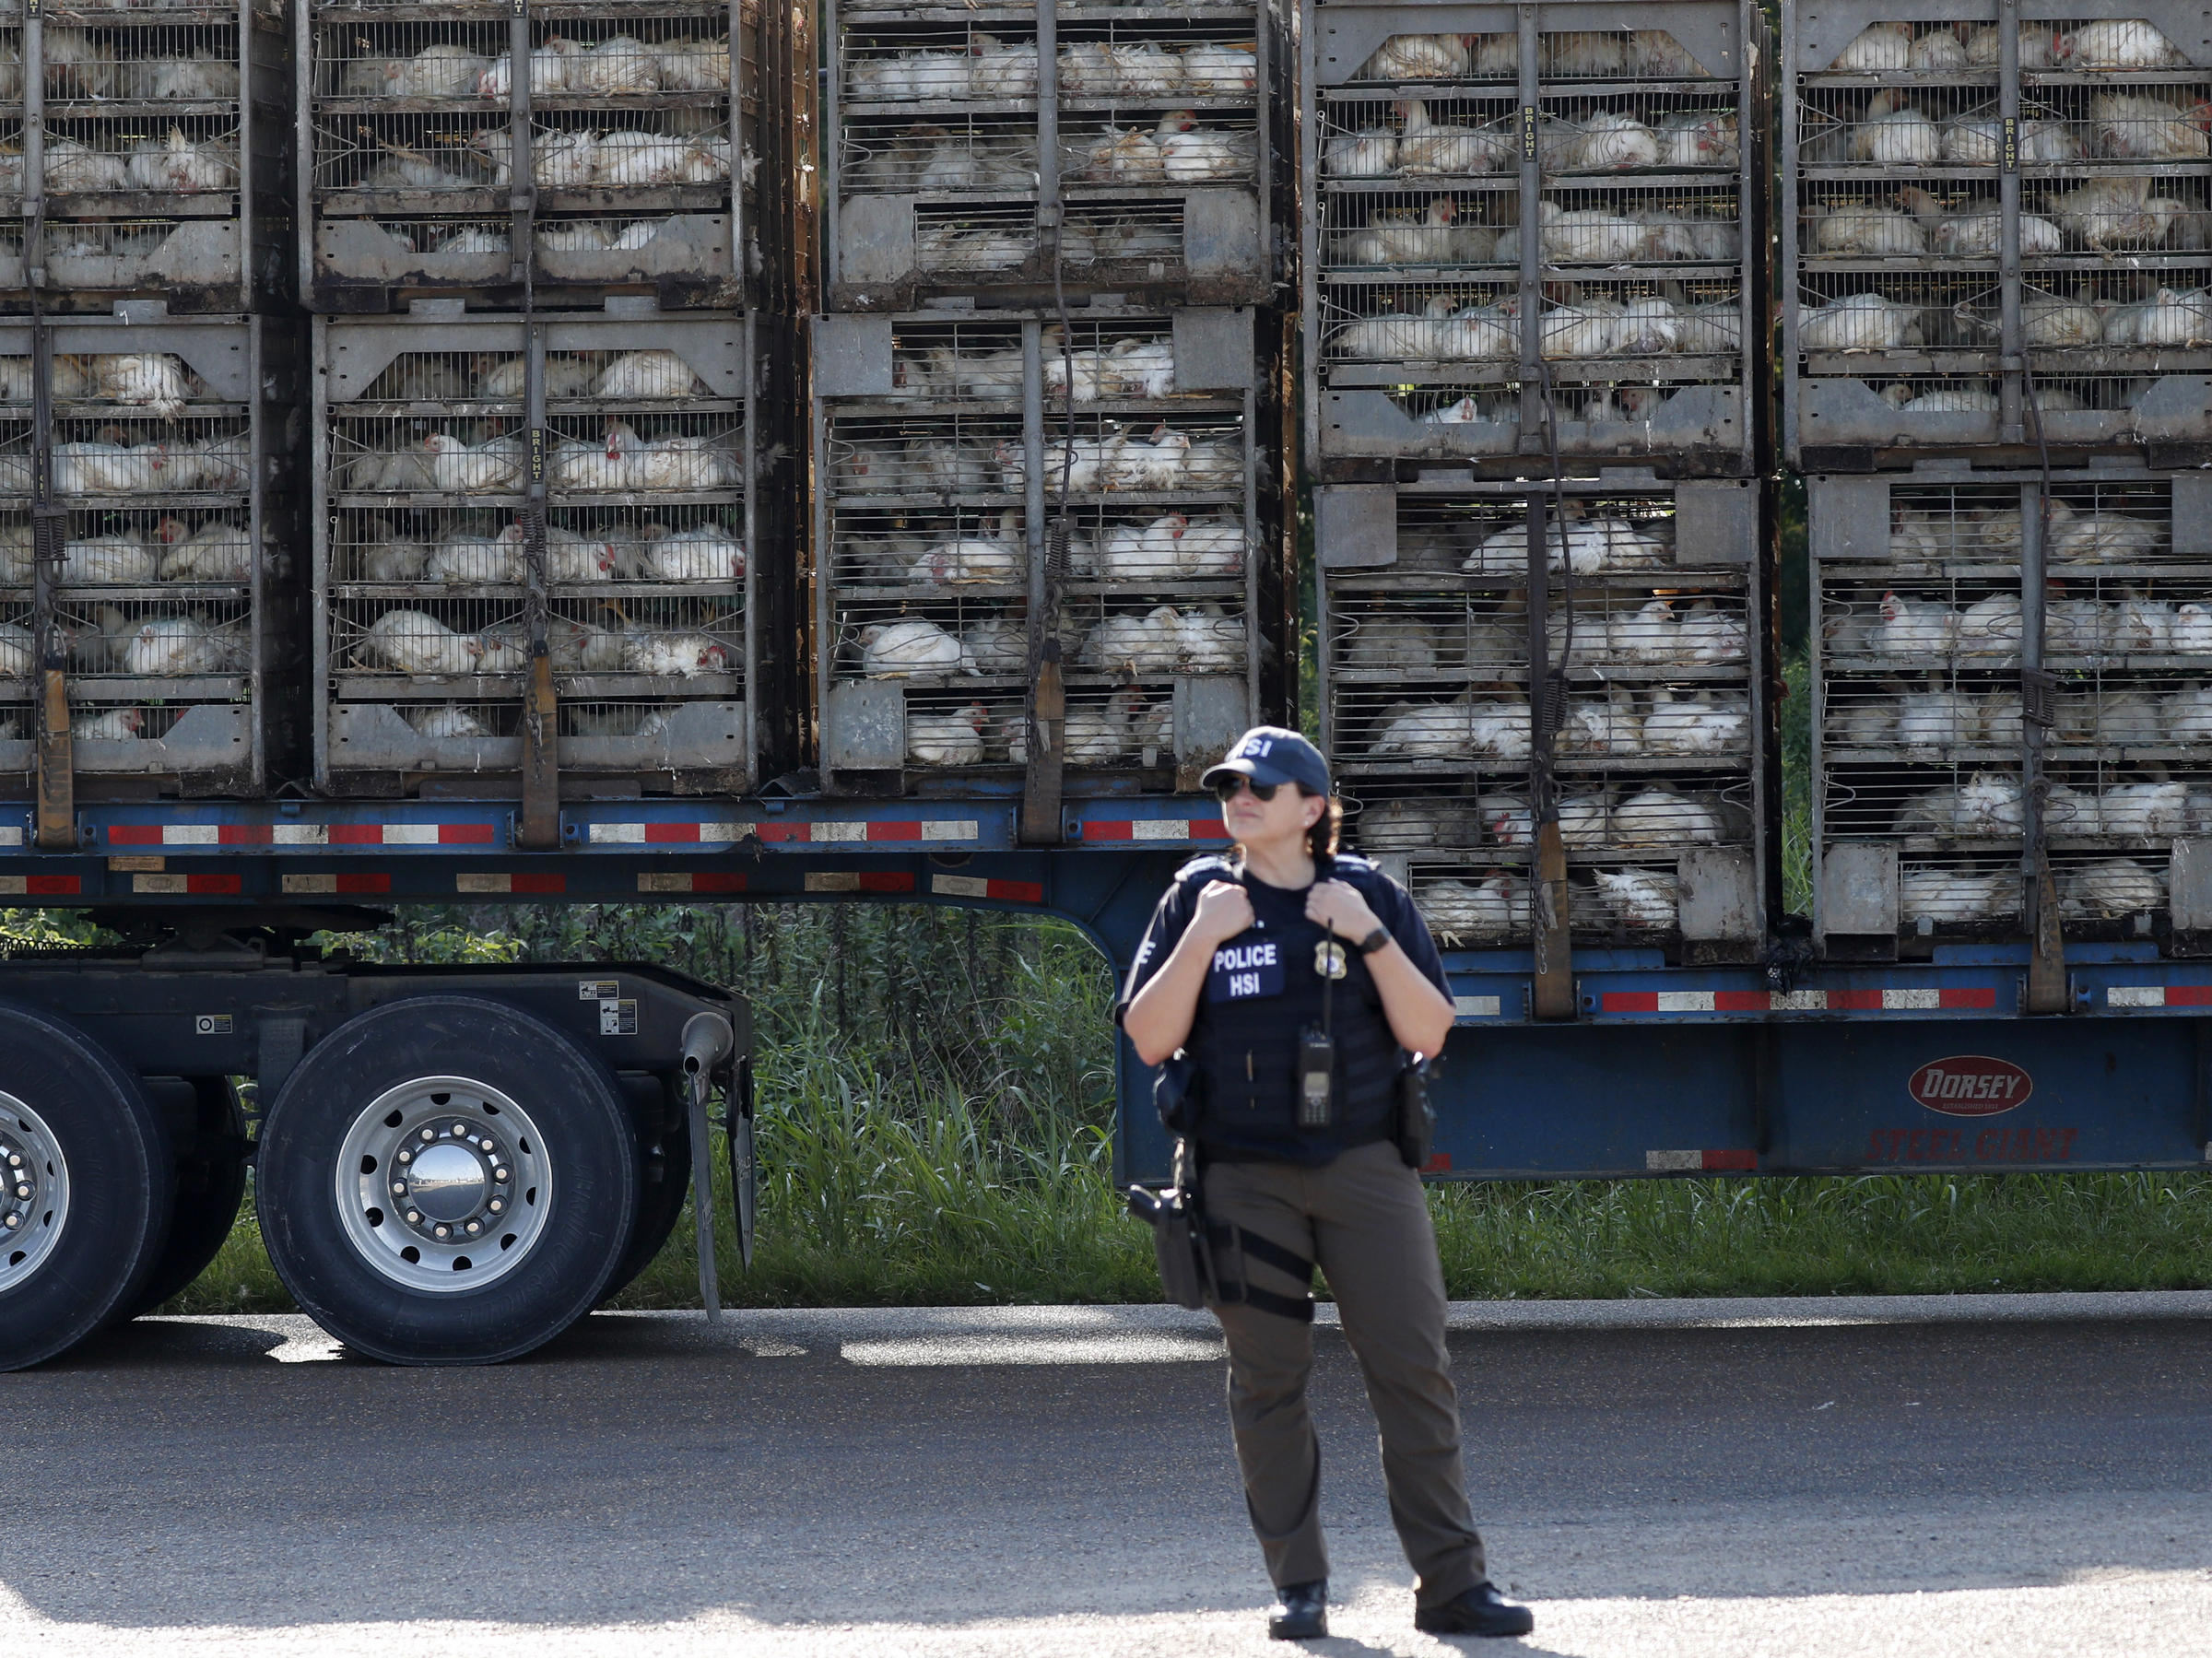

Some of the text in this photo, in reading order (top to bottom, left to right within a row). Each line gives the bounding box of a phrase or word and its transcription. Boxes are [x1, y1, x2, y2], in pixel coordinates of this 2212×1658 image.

[1524, 107, 1534, 157] BRIGHT
[2006, 119, 2015, 168] BRIGHT
[532, 429, 541, 479] BRIGHT
[1236, 737, 1274, 758] SI
[1214, 944, 1277, 972] POLICE
[1230, 972, 1260, 996] HSI
[1866, 1128, 1967, 1161] STEEL
